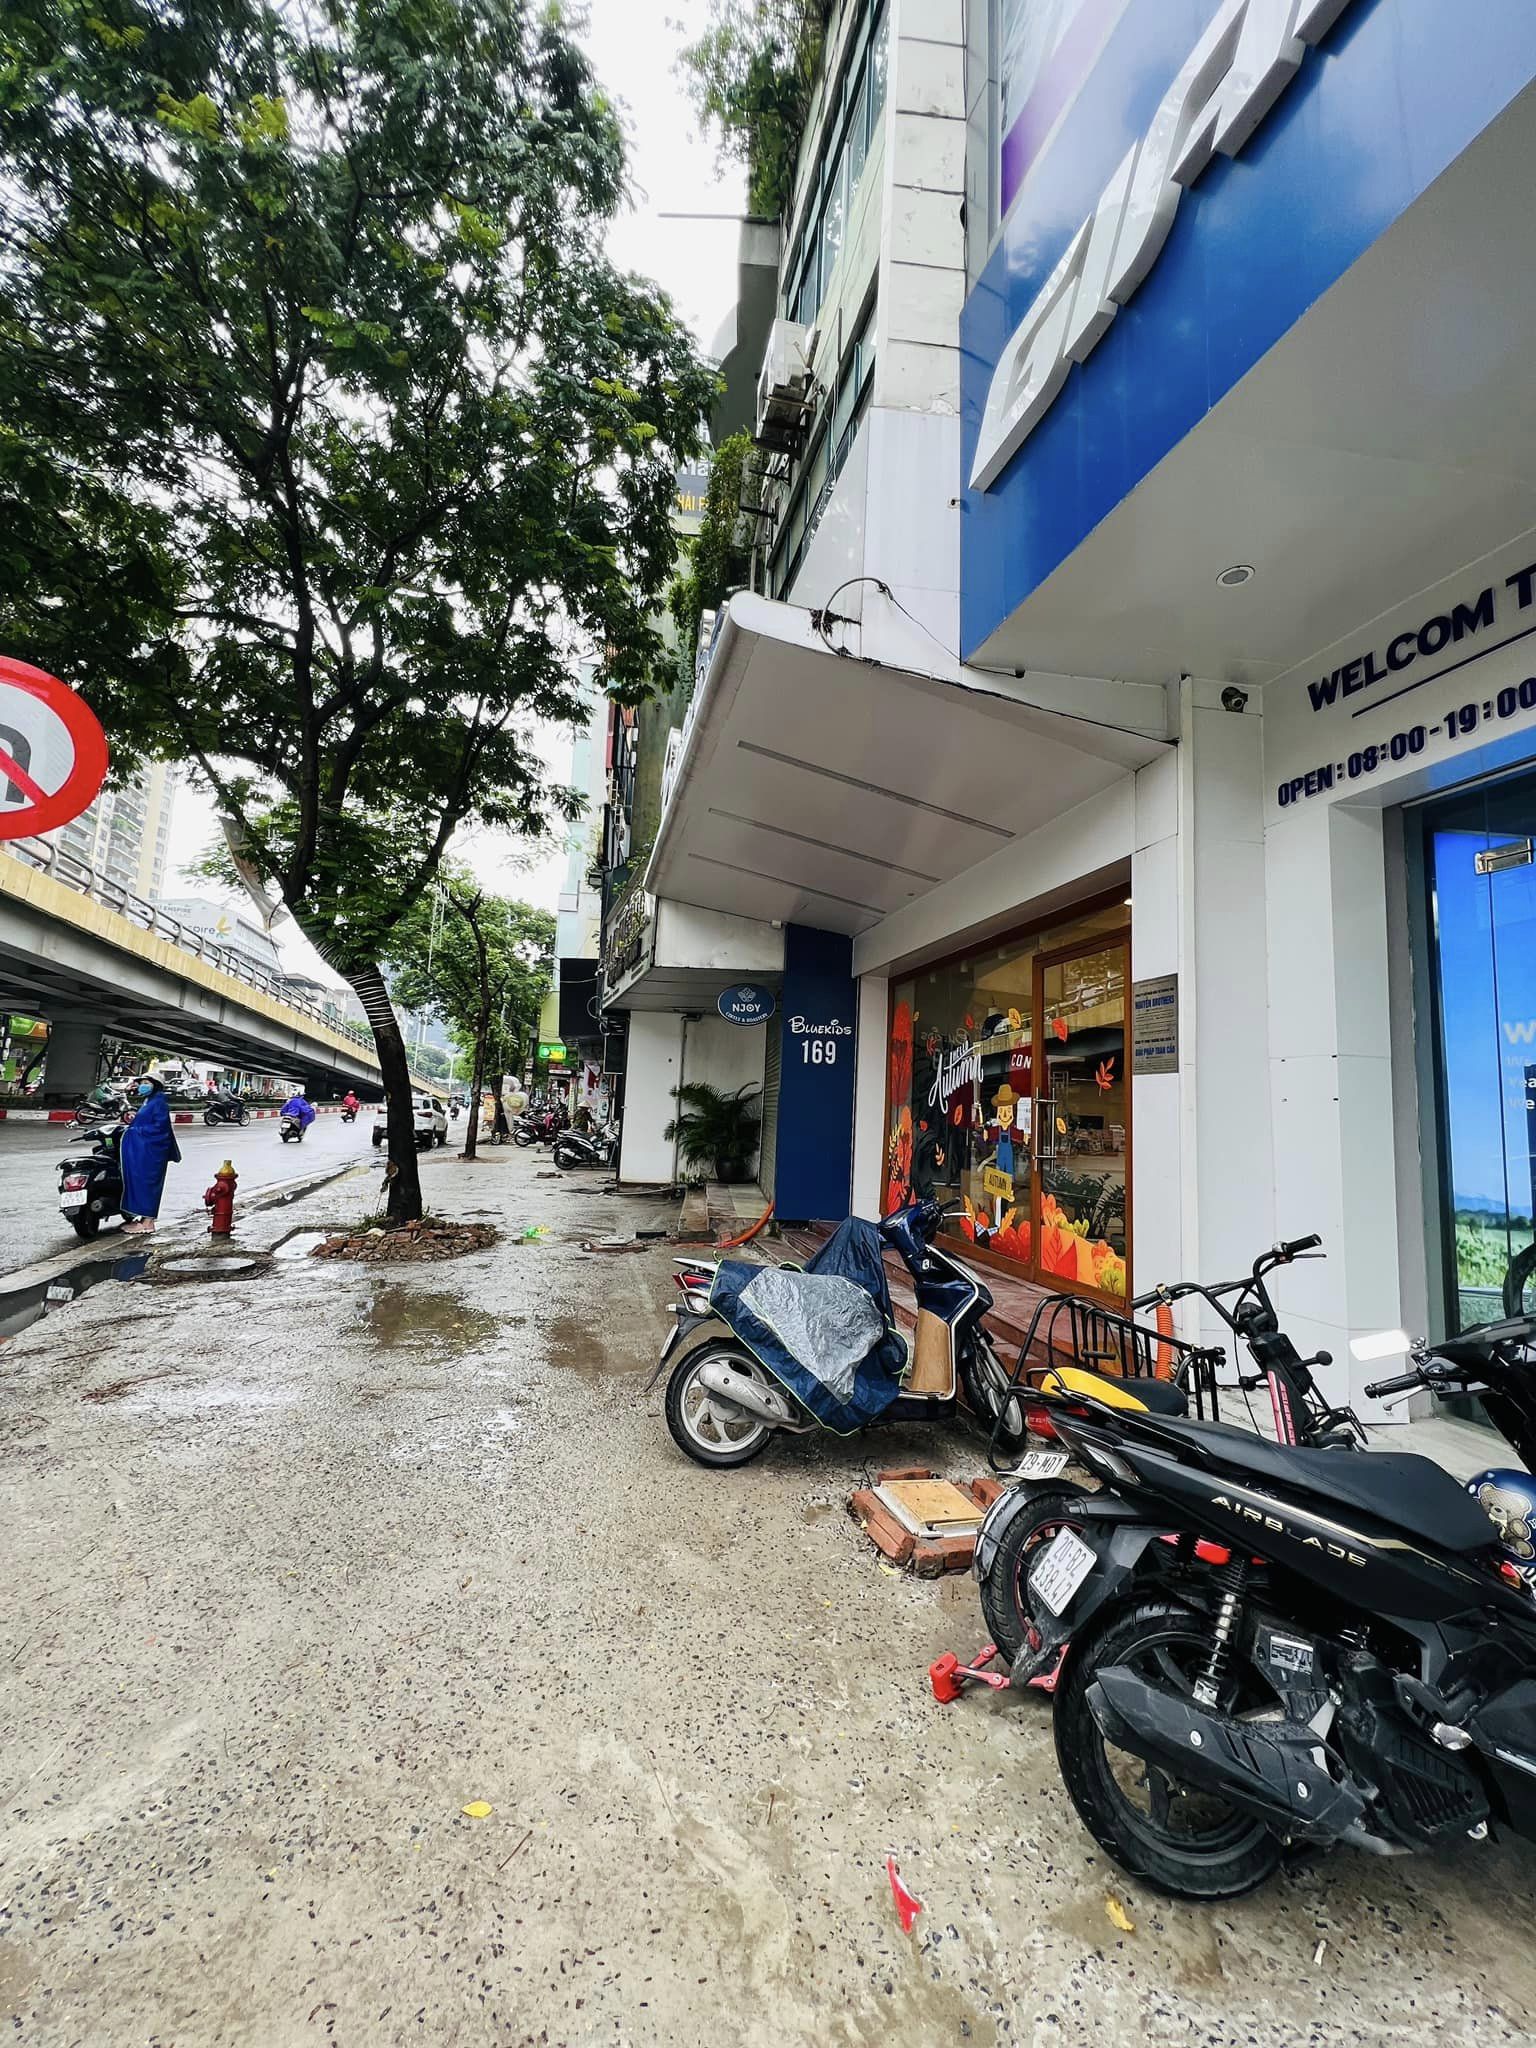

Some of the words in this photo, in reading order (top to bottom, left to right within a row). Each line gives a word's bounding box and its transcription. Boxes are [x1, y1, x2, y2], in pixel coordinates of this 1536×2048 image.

[1307, 588, 1496, 712] WELCOM
[732, 1003, 761, 1012] NJOY
[801, 1040, 837, 1065] 169
[928, 1045, 984, 1114] Autumn
[1053, 1535, 1087, 1577] 20-B2
[1035, 1558, 1073, 1606] 538.47
